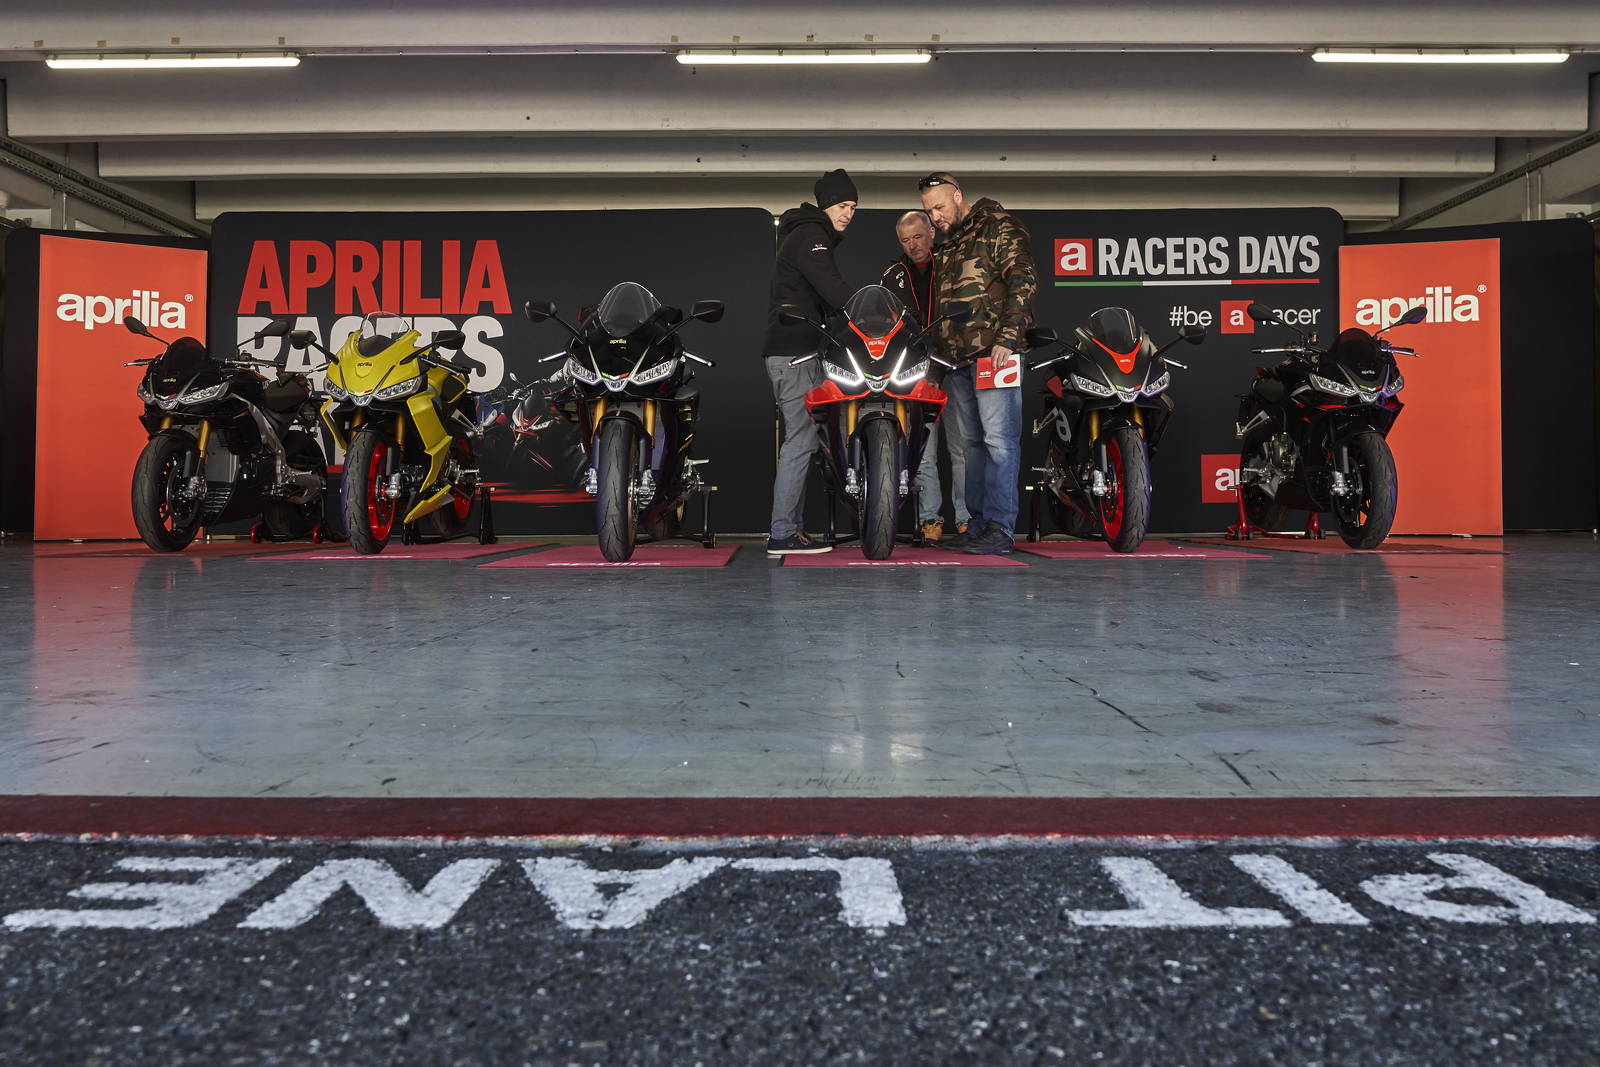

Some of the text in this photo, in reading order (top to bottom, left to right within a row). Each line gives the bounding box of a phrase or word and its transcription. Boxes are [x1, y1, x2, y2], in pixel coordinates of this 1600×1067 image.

[237, 239, 513, 314] APRILIA
[1098, 236, 1229, 276] RACERS
[1238, 235, 1320, 274] DAYS
[56, 289, 186, 330] aprilia
[1169, 305, 1321, 326] #be a acer
[1355, 286, 1480, 331] aprilia
[2, 853, 1598, 931] PIT LANE
